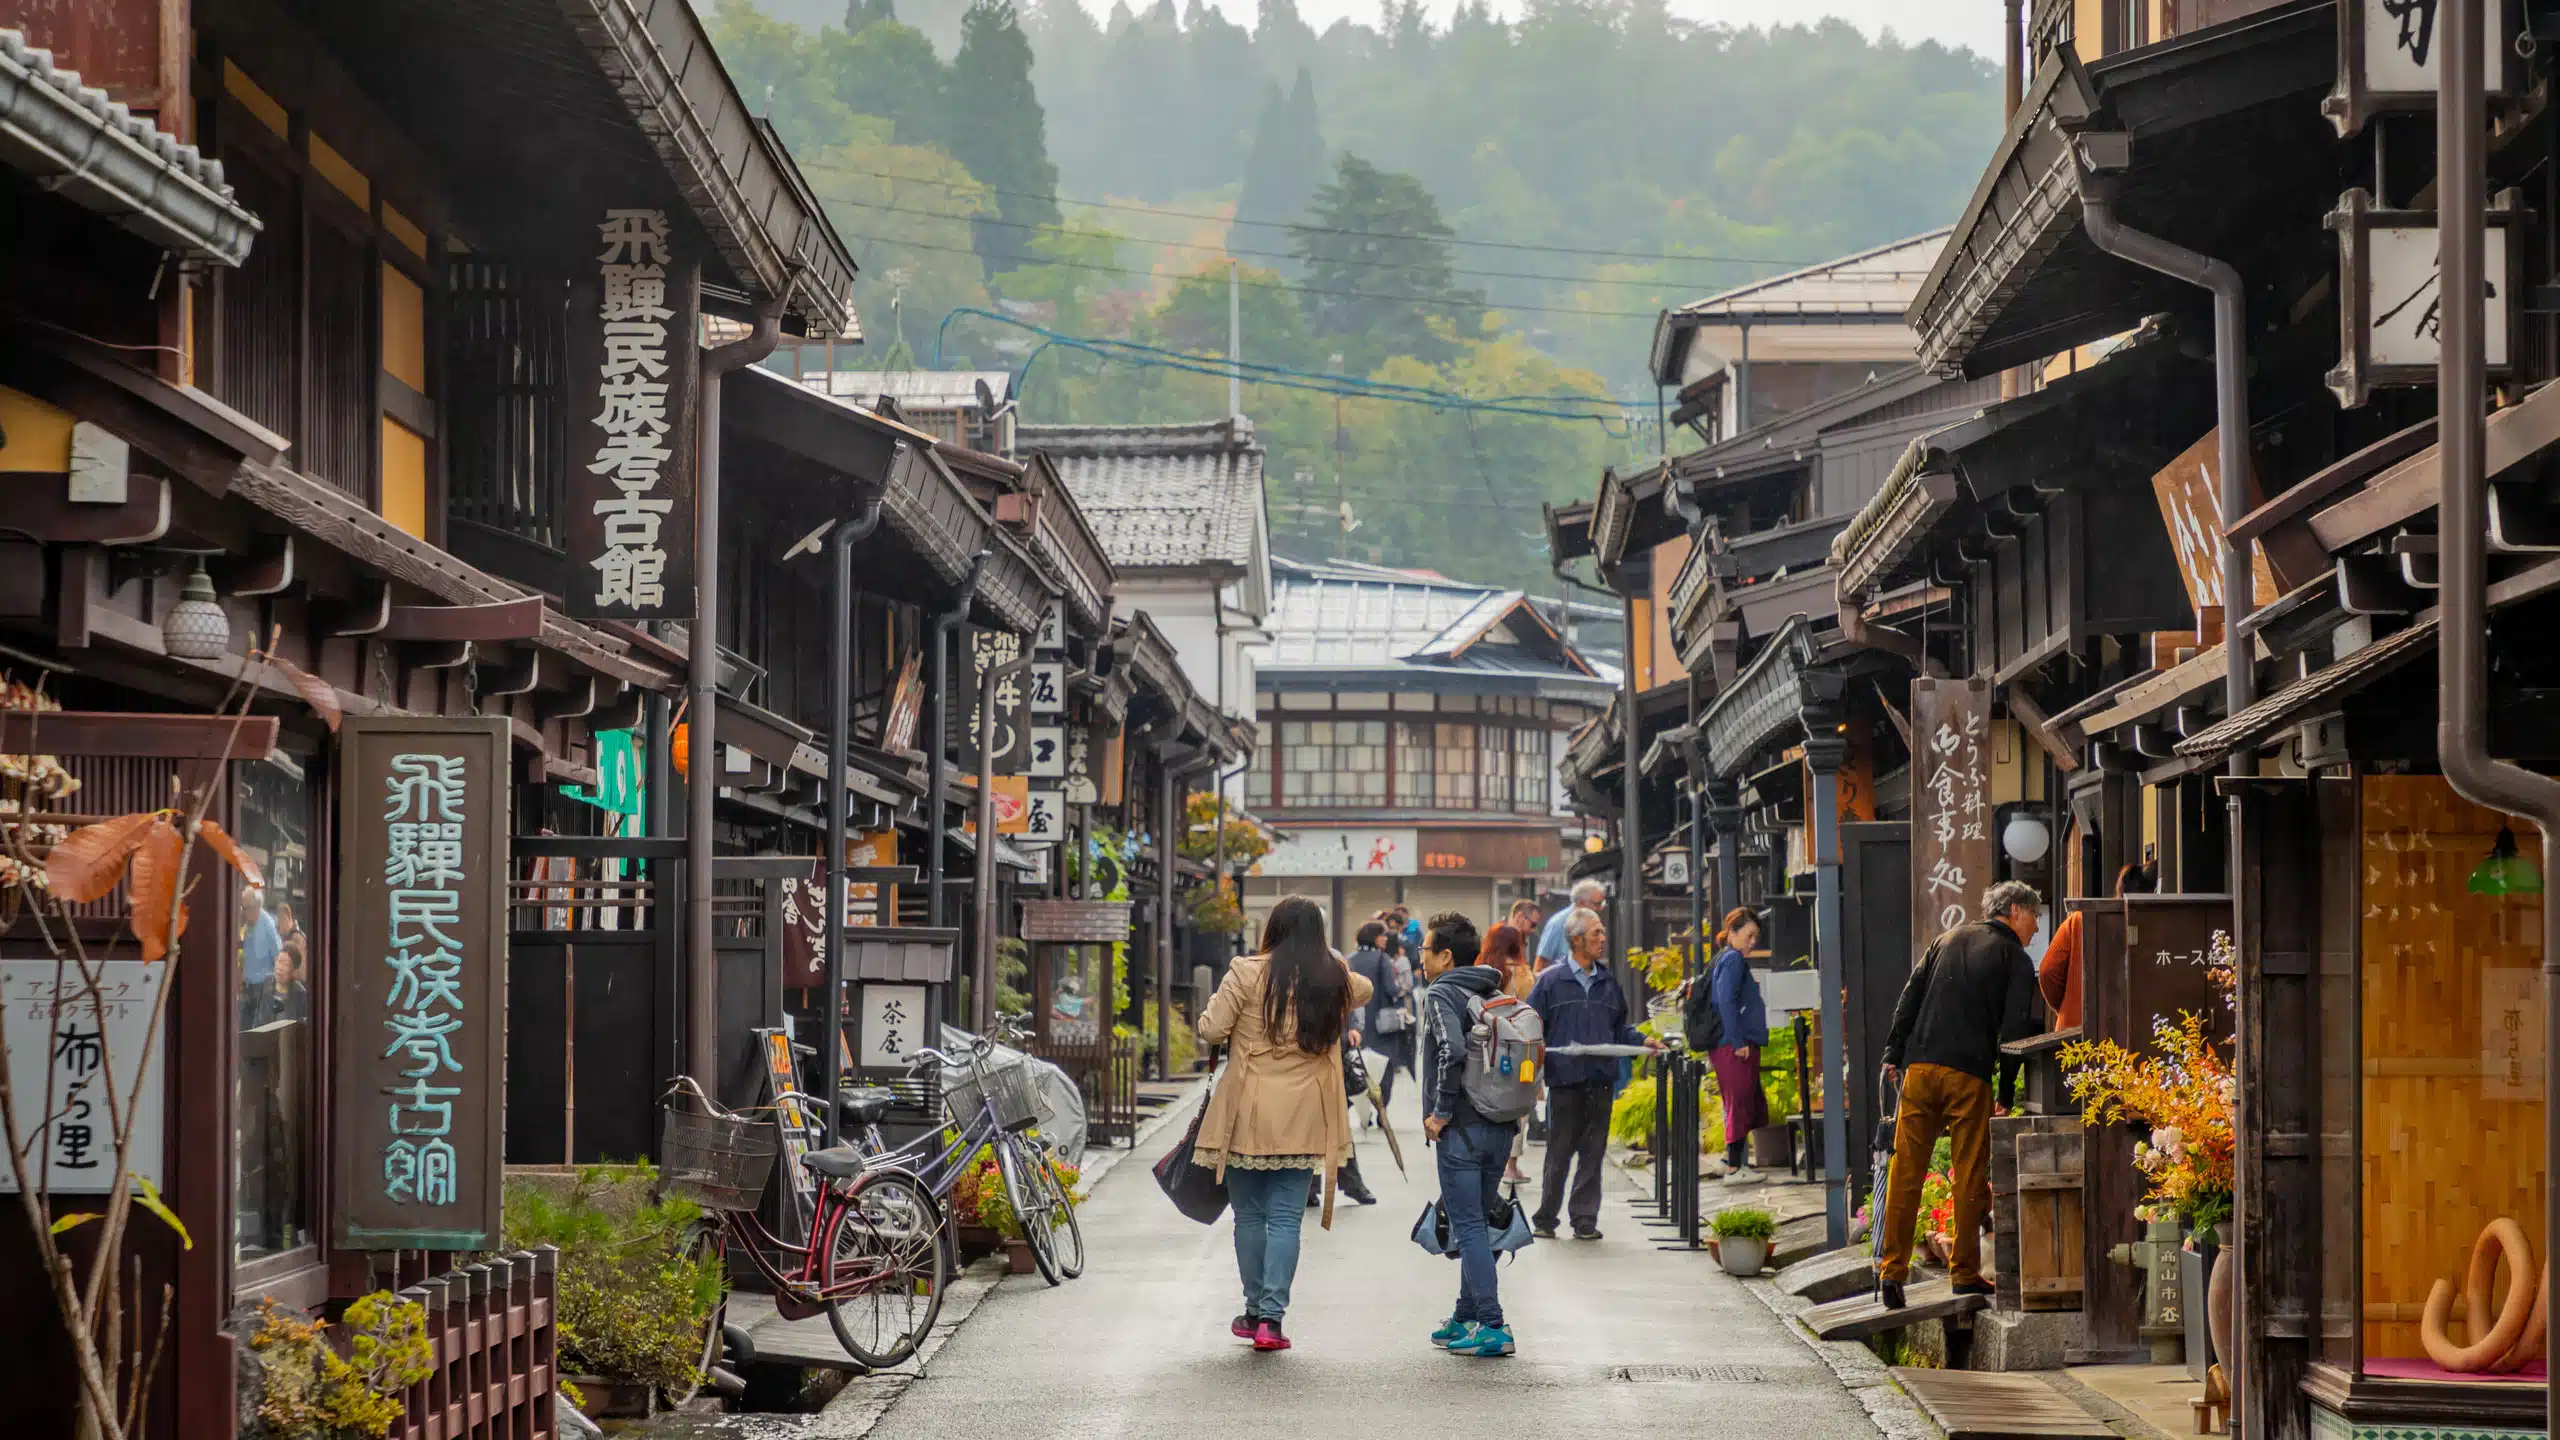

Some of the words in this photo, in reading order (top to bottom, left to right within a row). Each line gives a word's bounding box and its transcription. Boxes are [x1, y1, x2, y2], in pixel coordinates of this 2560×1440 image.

[1960, 710, 1987, 841] とうふ料理
[28, 981, 130, 997] アンテーク
[878, 999, 907, 1054] 茶屋
[55, 1023, 102, 1169] 布ら里
